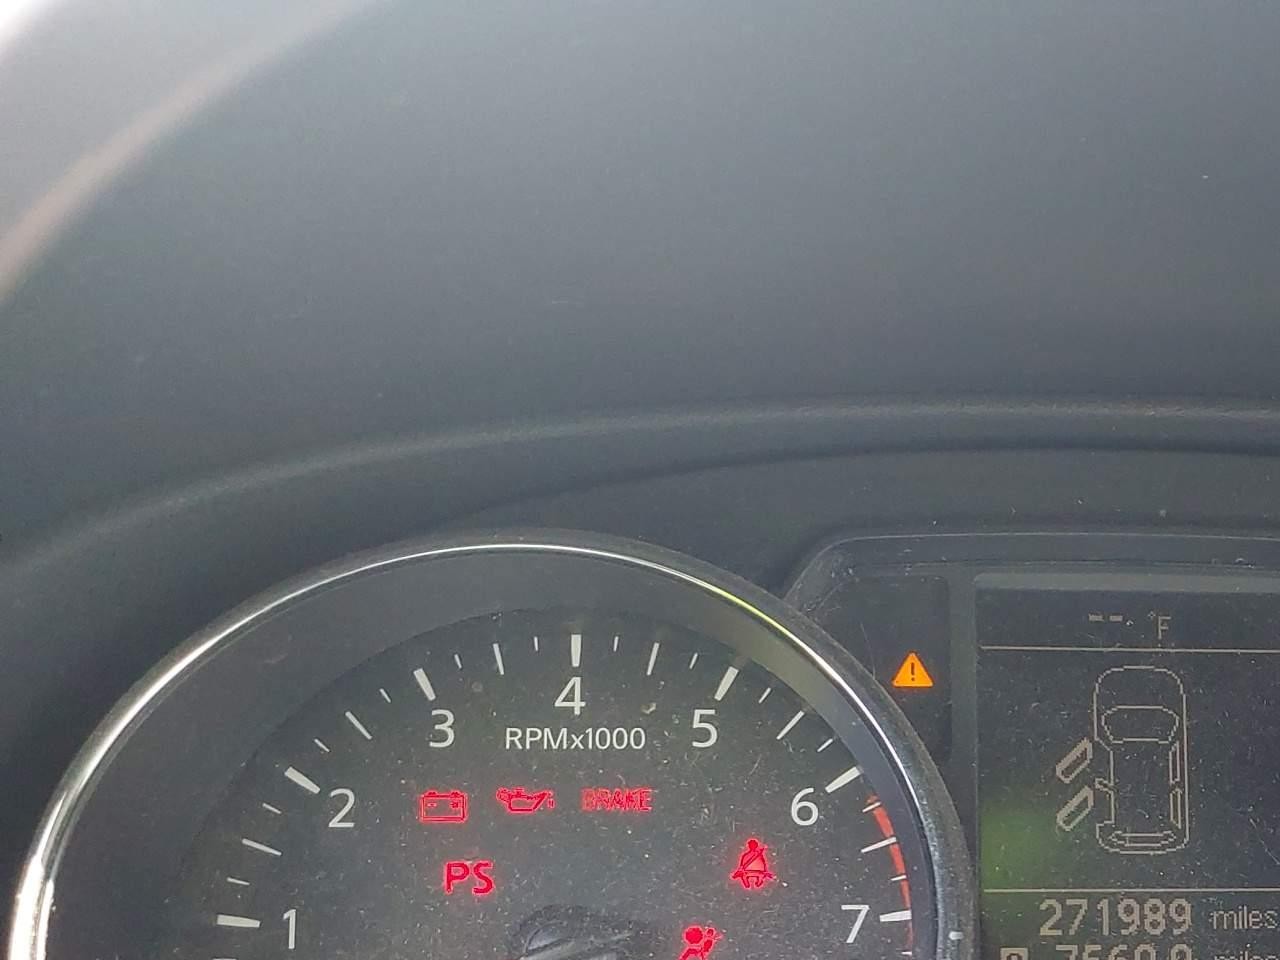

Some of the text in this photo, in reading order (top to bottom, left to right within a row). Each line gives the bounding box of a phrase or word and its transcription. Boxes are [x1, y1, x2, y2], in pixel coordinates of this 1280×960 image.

[554, 676, 586, 716] 4
[429, 709, 456, 748] 3
[505, 727, 646, 750] RPMx1000
[691, 708, 718, 748] 5
[328, 788, 356, 828] 2
[581, 787, 654, 812] BRAKE
[790, 787, 819, 826] 6
[444, 861, 495, 895] PS
[282, 908, 297, 949] 1
[840, 904, 870, 943] 7
[1039, 899, 1279, 936] 271989 miles
